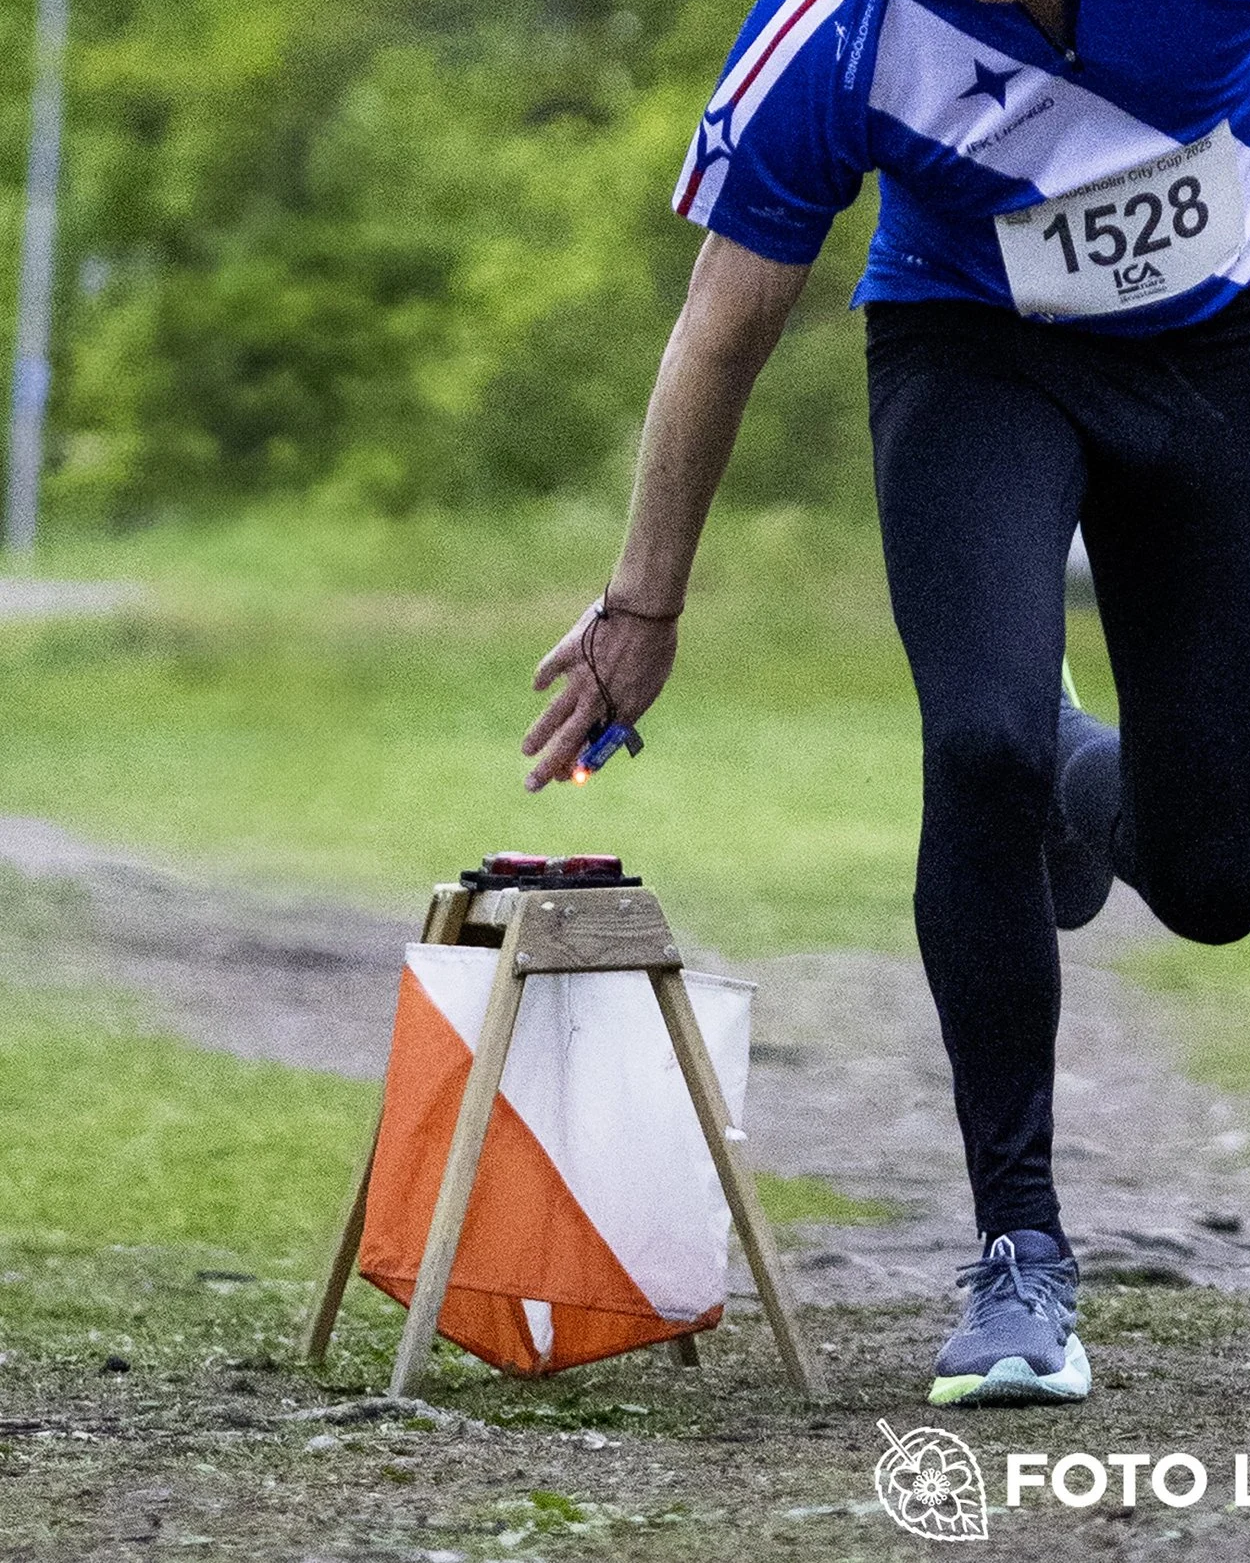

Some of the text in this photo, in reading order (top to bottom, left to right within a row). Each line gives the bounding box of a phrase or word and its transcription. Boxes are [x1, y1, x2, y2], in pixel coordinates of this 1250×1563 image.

[1128, 167, 1154, 187] City
[1156, 153, 1183, 173] Cup
[1184, 137, 1212, 159] 2025
[1043, 175, 1210, 274] 1528
[1112, 261, 1163, 288] ICA
